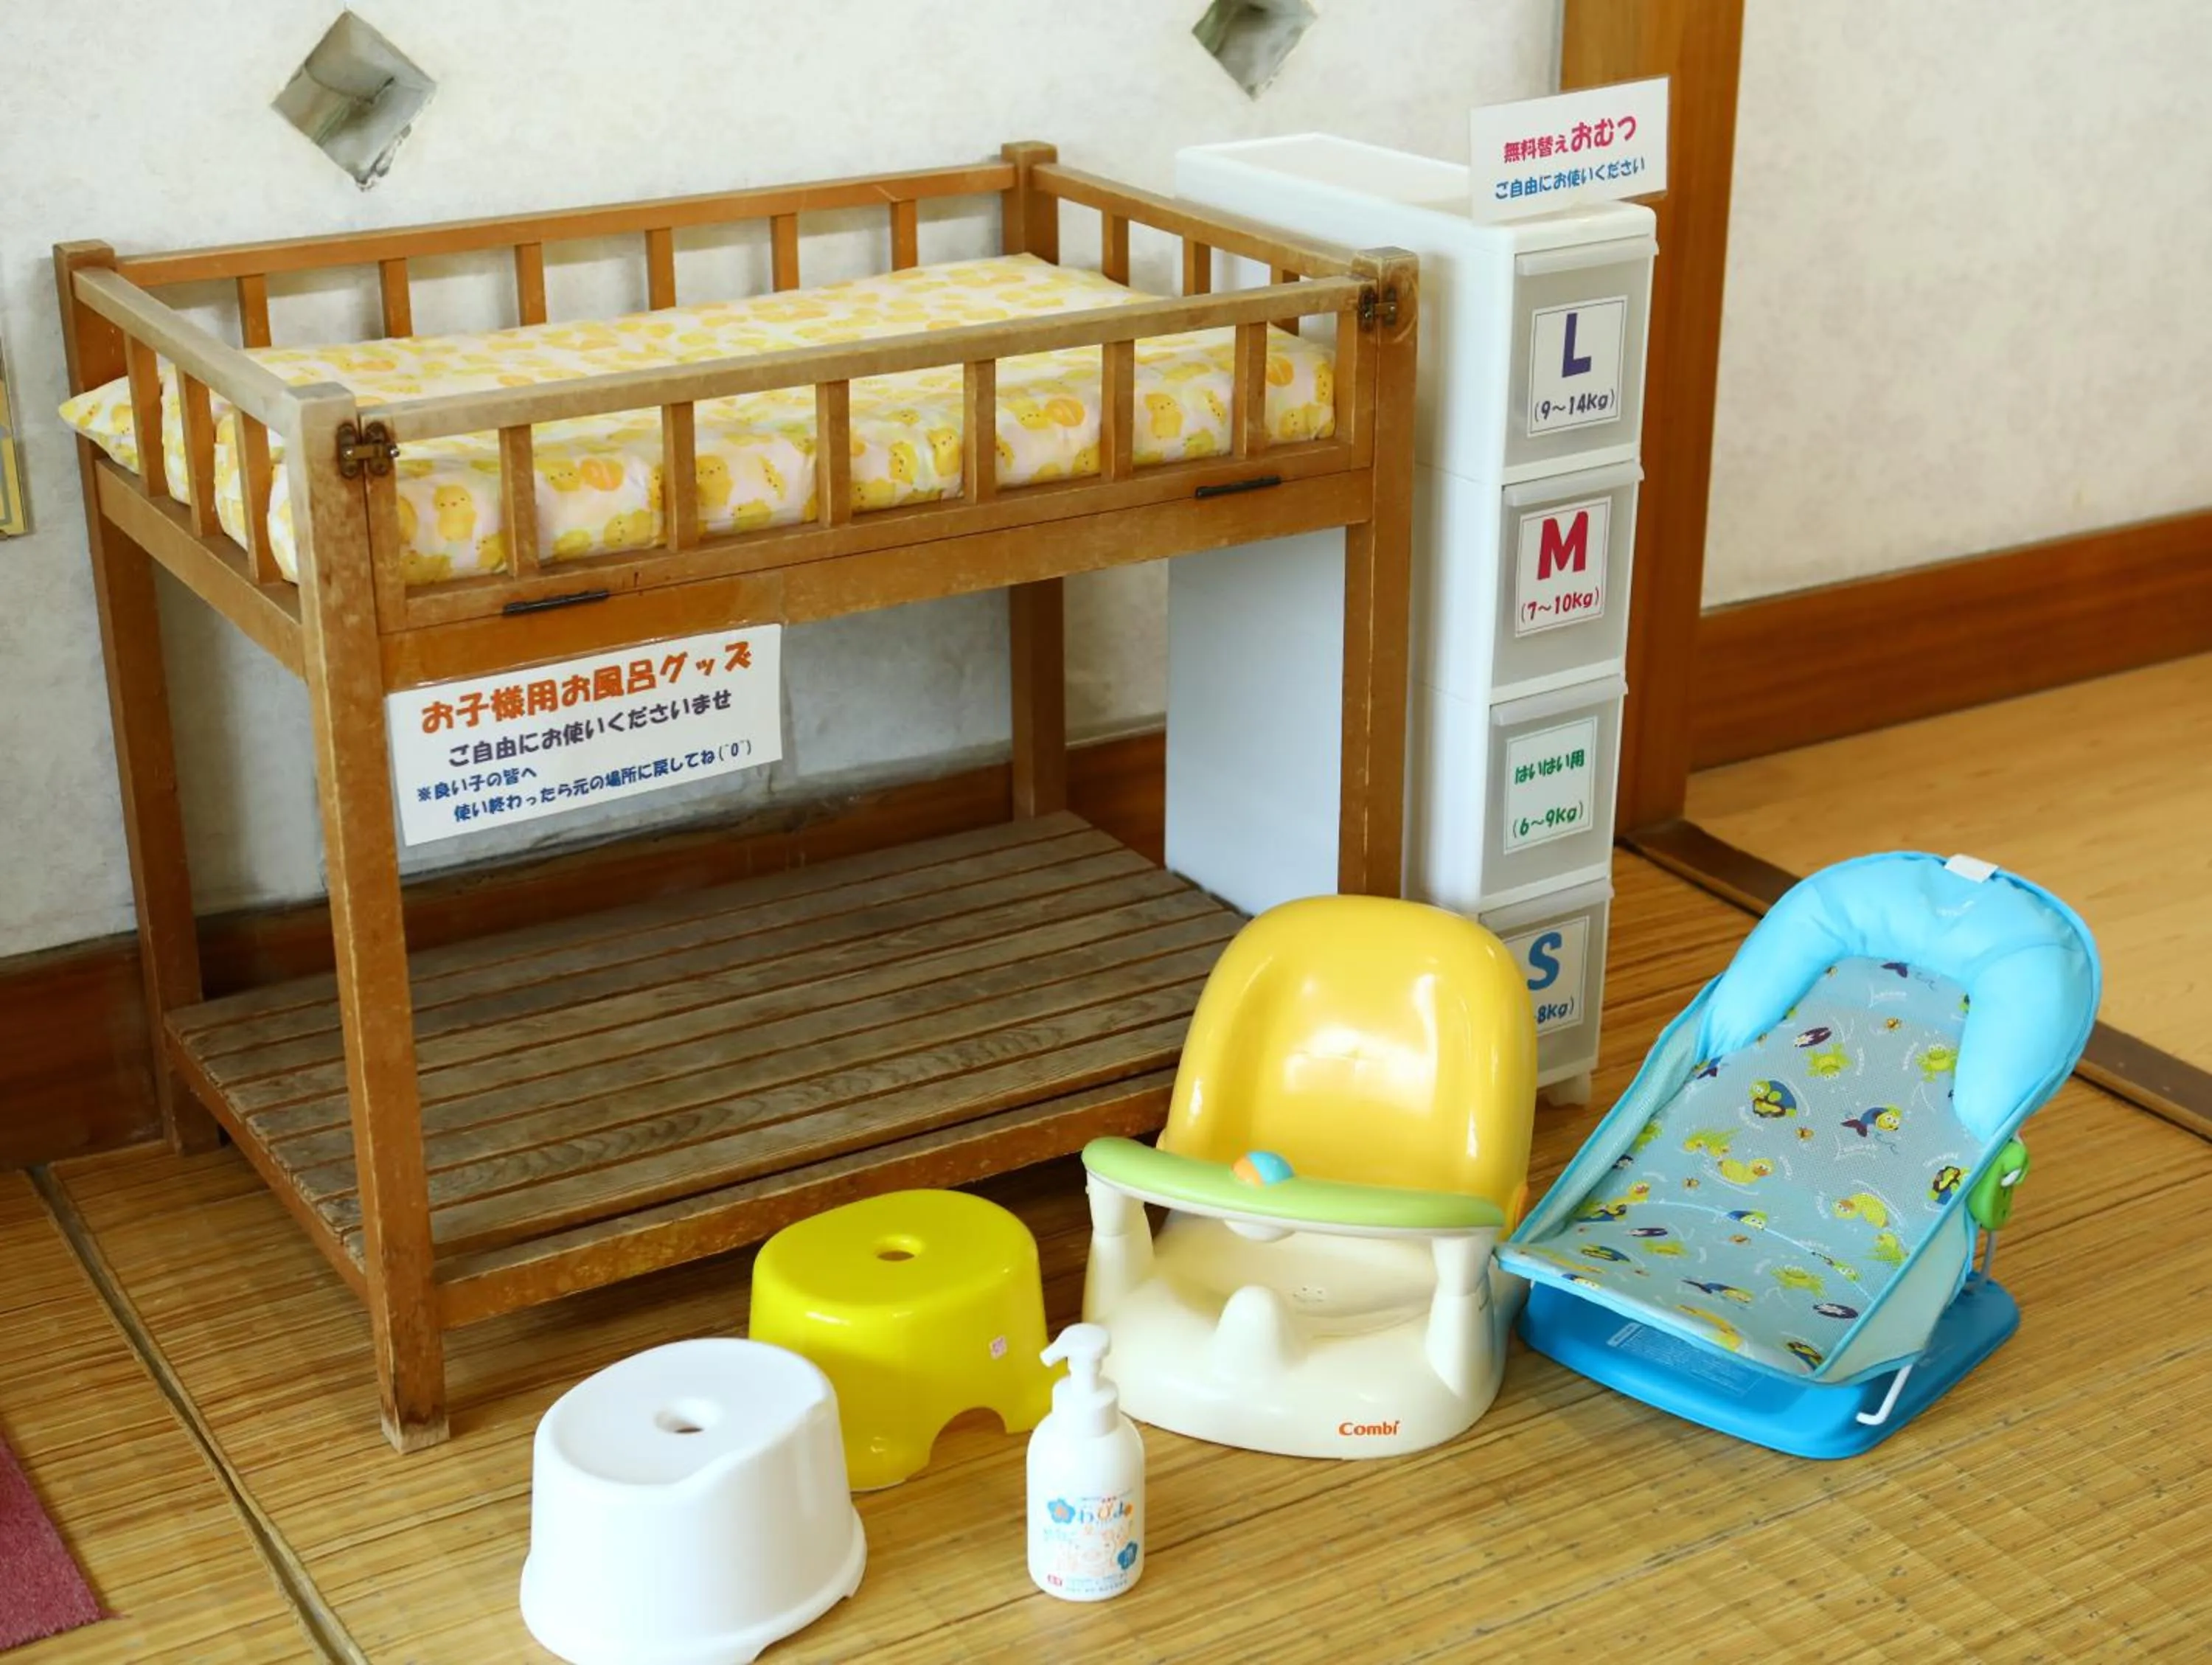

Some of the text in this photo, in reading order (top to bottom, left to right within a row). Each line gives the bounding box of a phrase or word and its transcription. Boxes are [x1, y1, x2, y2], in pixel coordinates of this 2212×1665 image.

[1503, 116, 1637, 164] 無料替えおむつ
[1495, 158, 1646, 200] ご自由にお使いください
[1562, 313, 1591, 378] L
[1537, 511, 1589, 580] M
[421, 641, 753, 734] お子様用お風呂グッズ
[448, 689, 732, 768] ご自由にお使いくださいませ
[1514, 748, 1585, 785] はいはい用
[1527, 931, 1562, 990] S
[1338, 1420, 1400, 1436] Combi
